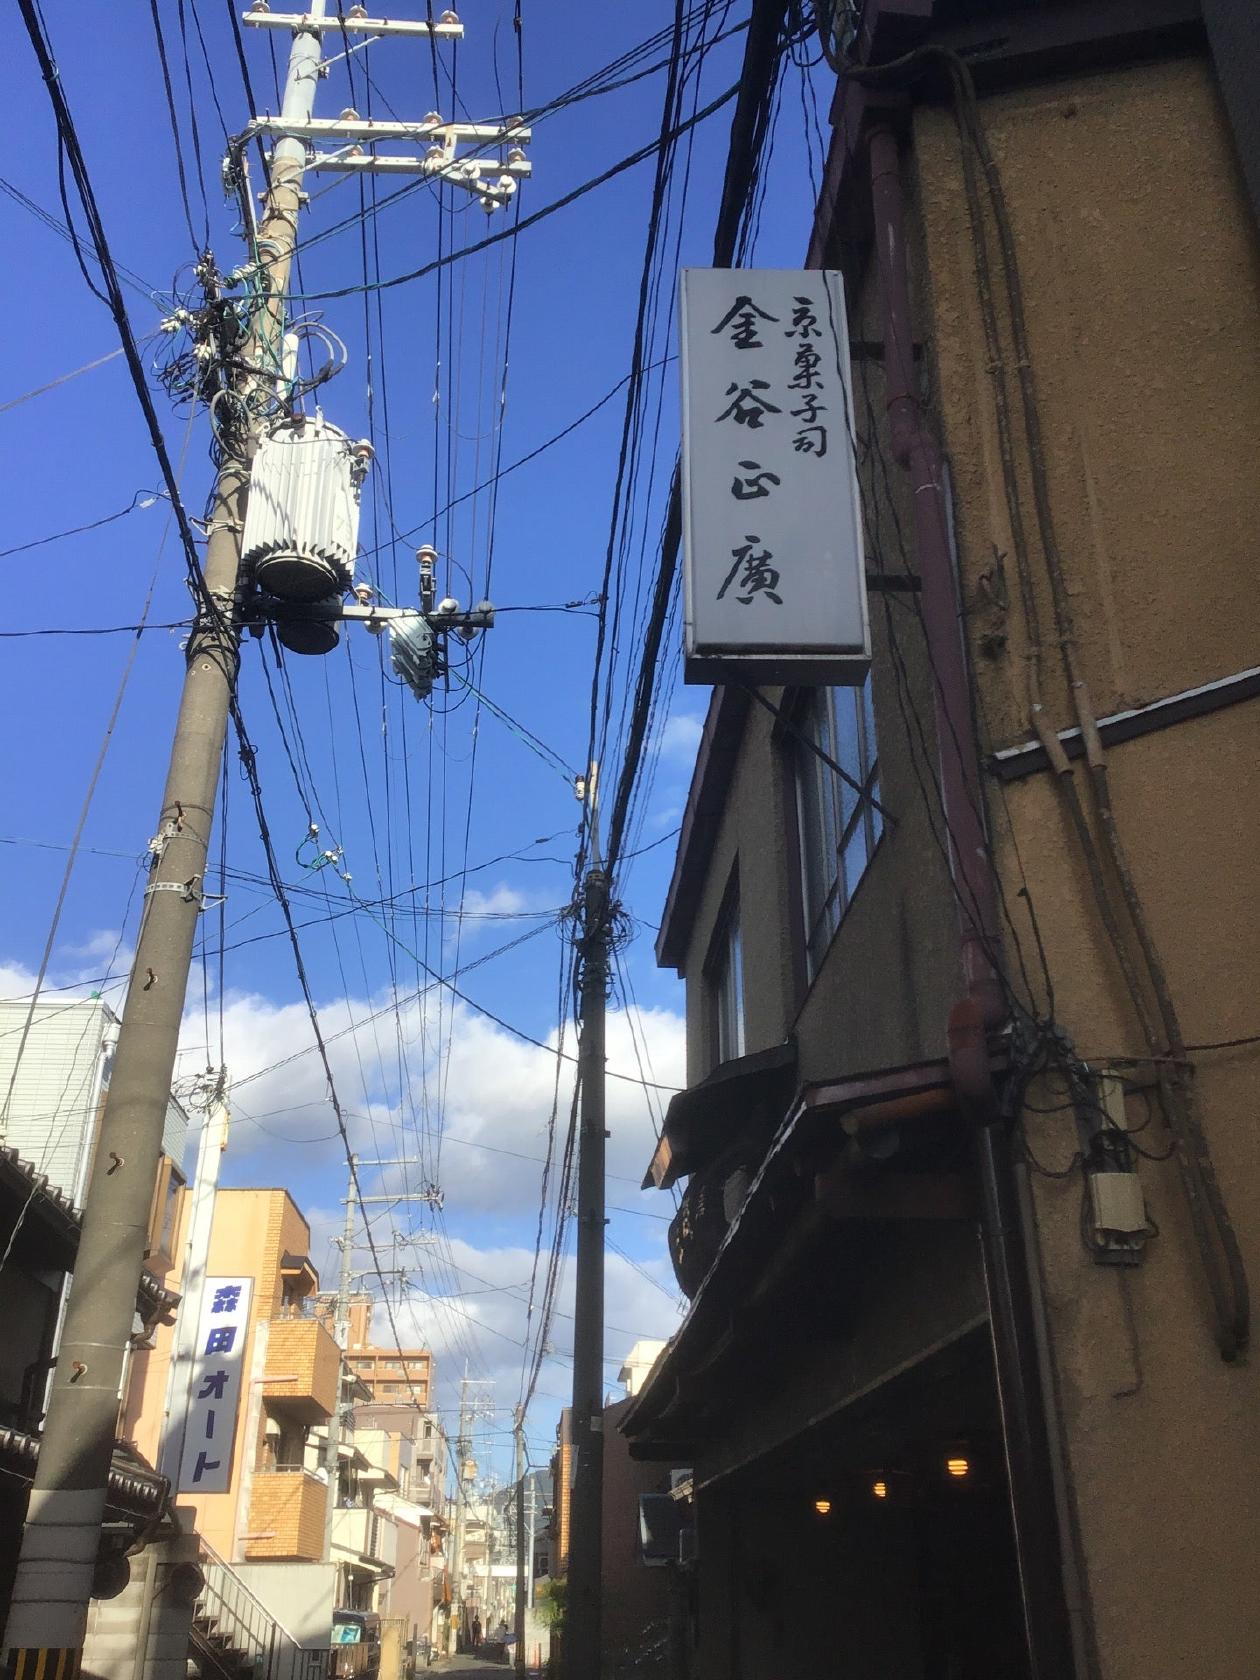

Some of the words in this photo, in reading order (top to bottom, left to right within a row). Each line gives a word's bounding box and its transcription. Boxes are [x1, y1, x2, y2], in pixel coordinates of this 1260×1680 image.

[711, 295, 784, 605] 金谷正廣
[785, 296, 827, 458] 京菓子司
[193, 1285, 242, 1483] 森田オート
